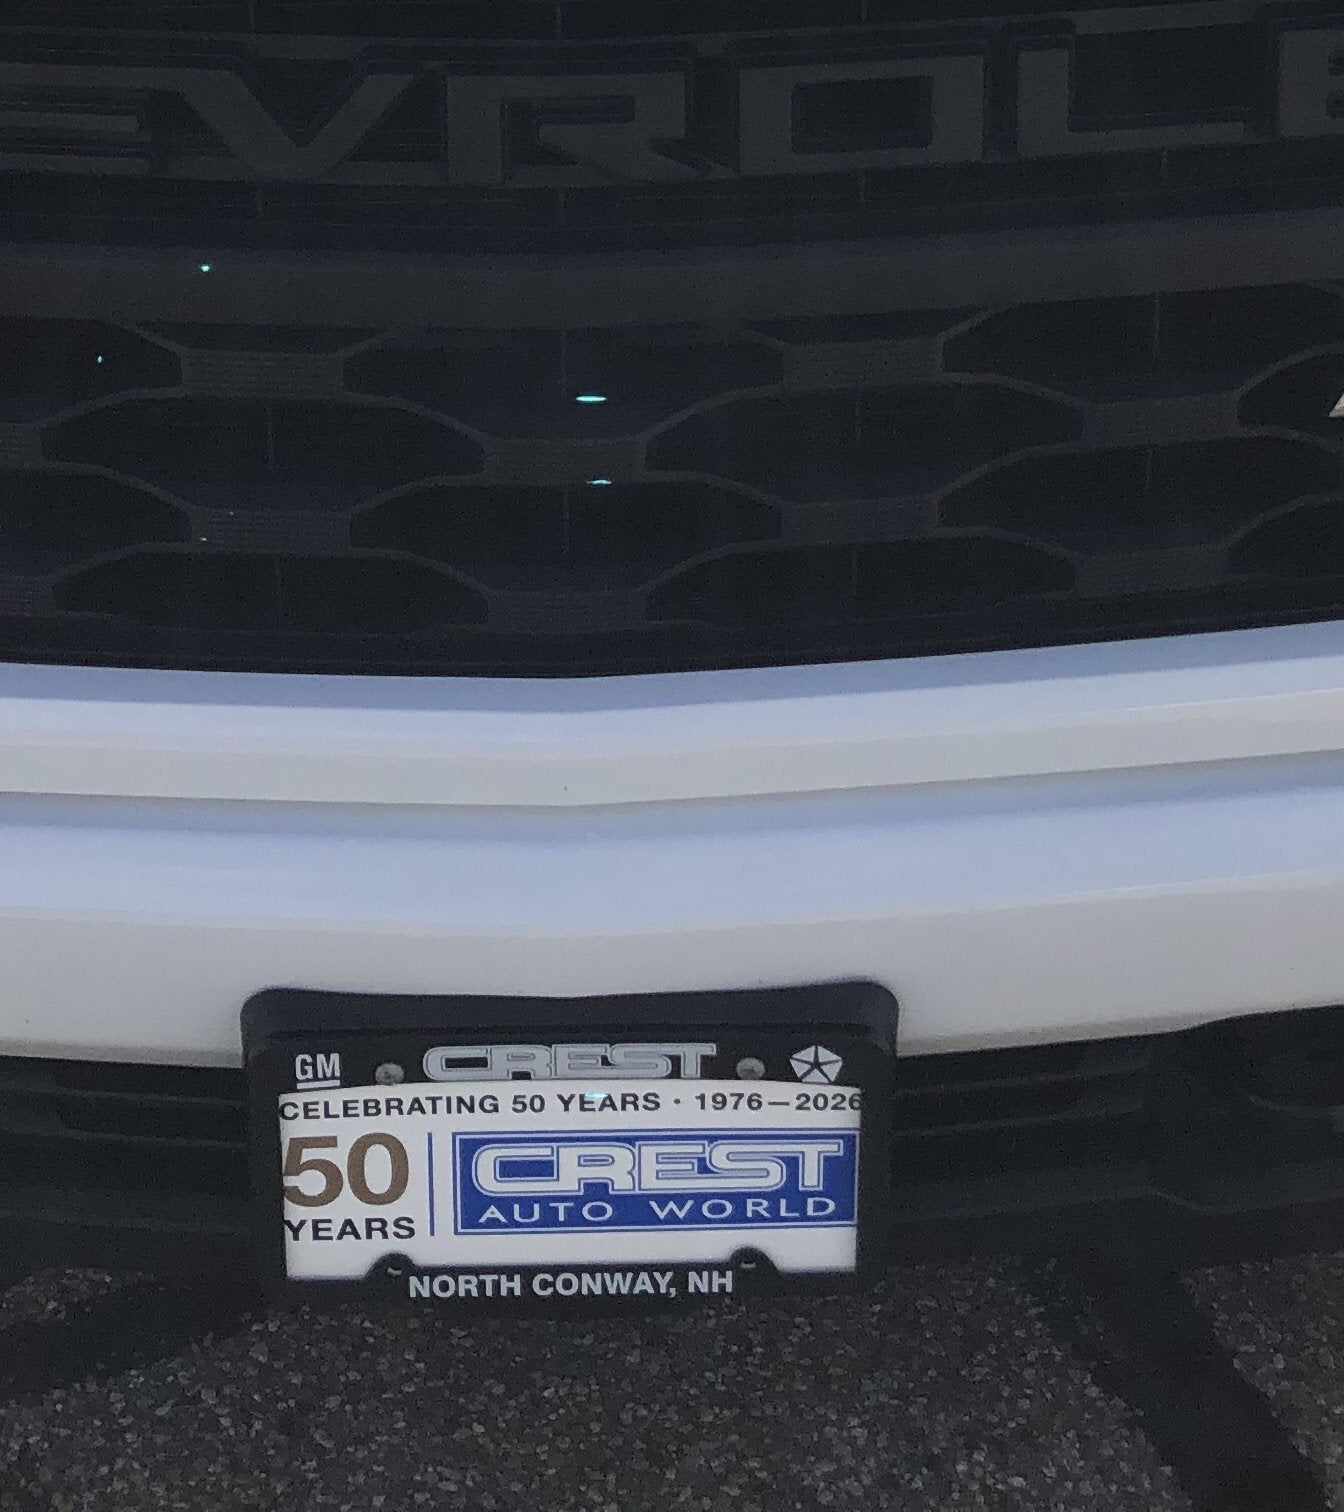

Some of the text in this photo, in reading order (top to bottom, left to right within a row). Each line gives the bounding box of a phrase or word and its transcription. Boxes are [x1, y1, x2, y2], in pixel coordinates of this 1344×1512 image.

[295, 1053, 341, 1081] GM
[423, 1044, 716, 1081] CREST
[279, 1095, 500, 1121] CELEBRATING
[511, 1094, 546, 1114] 50
[557, 1092, 661, 1113] YEARS
[282, 1132, 409, 1207] 50
[472, 1139, 844, 1197] CREST
[478, 1197, 836, 1223] AUTO WORLD
[284, 1216, 416, 1241] YEARS
[409, 1271, 733, 1298] NORTH CONWAY, NH
